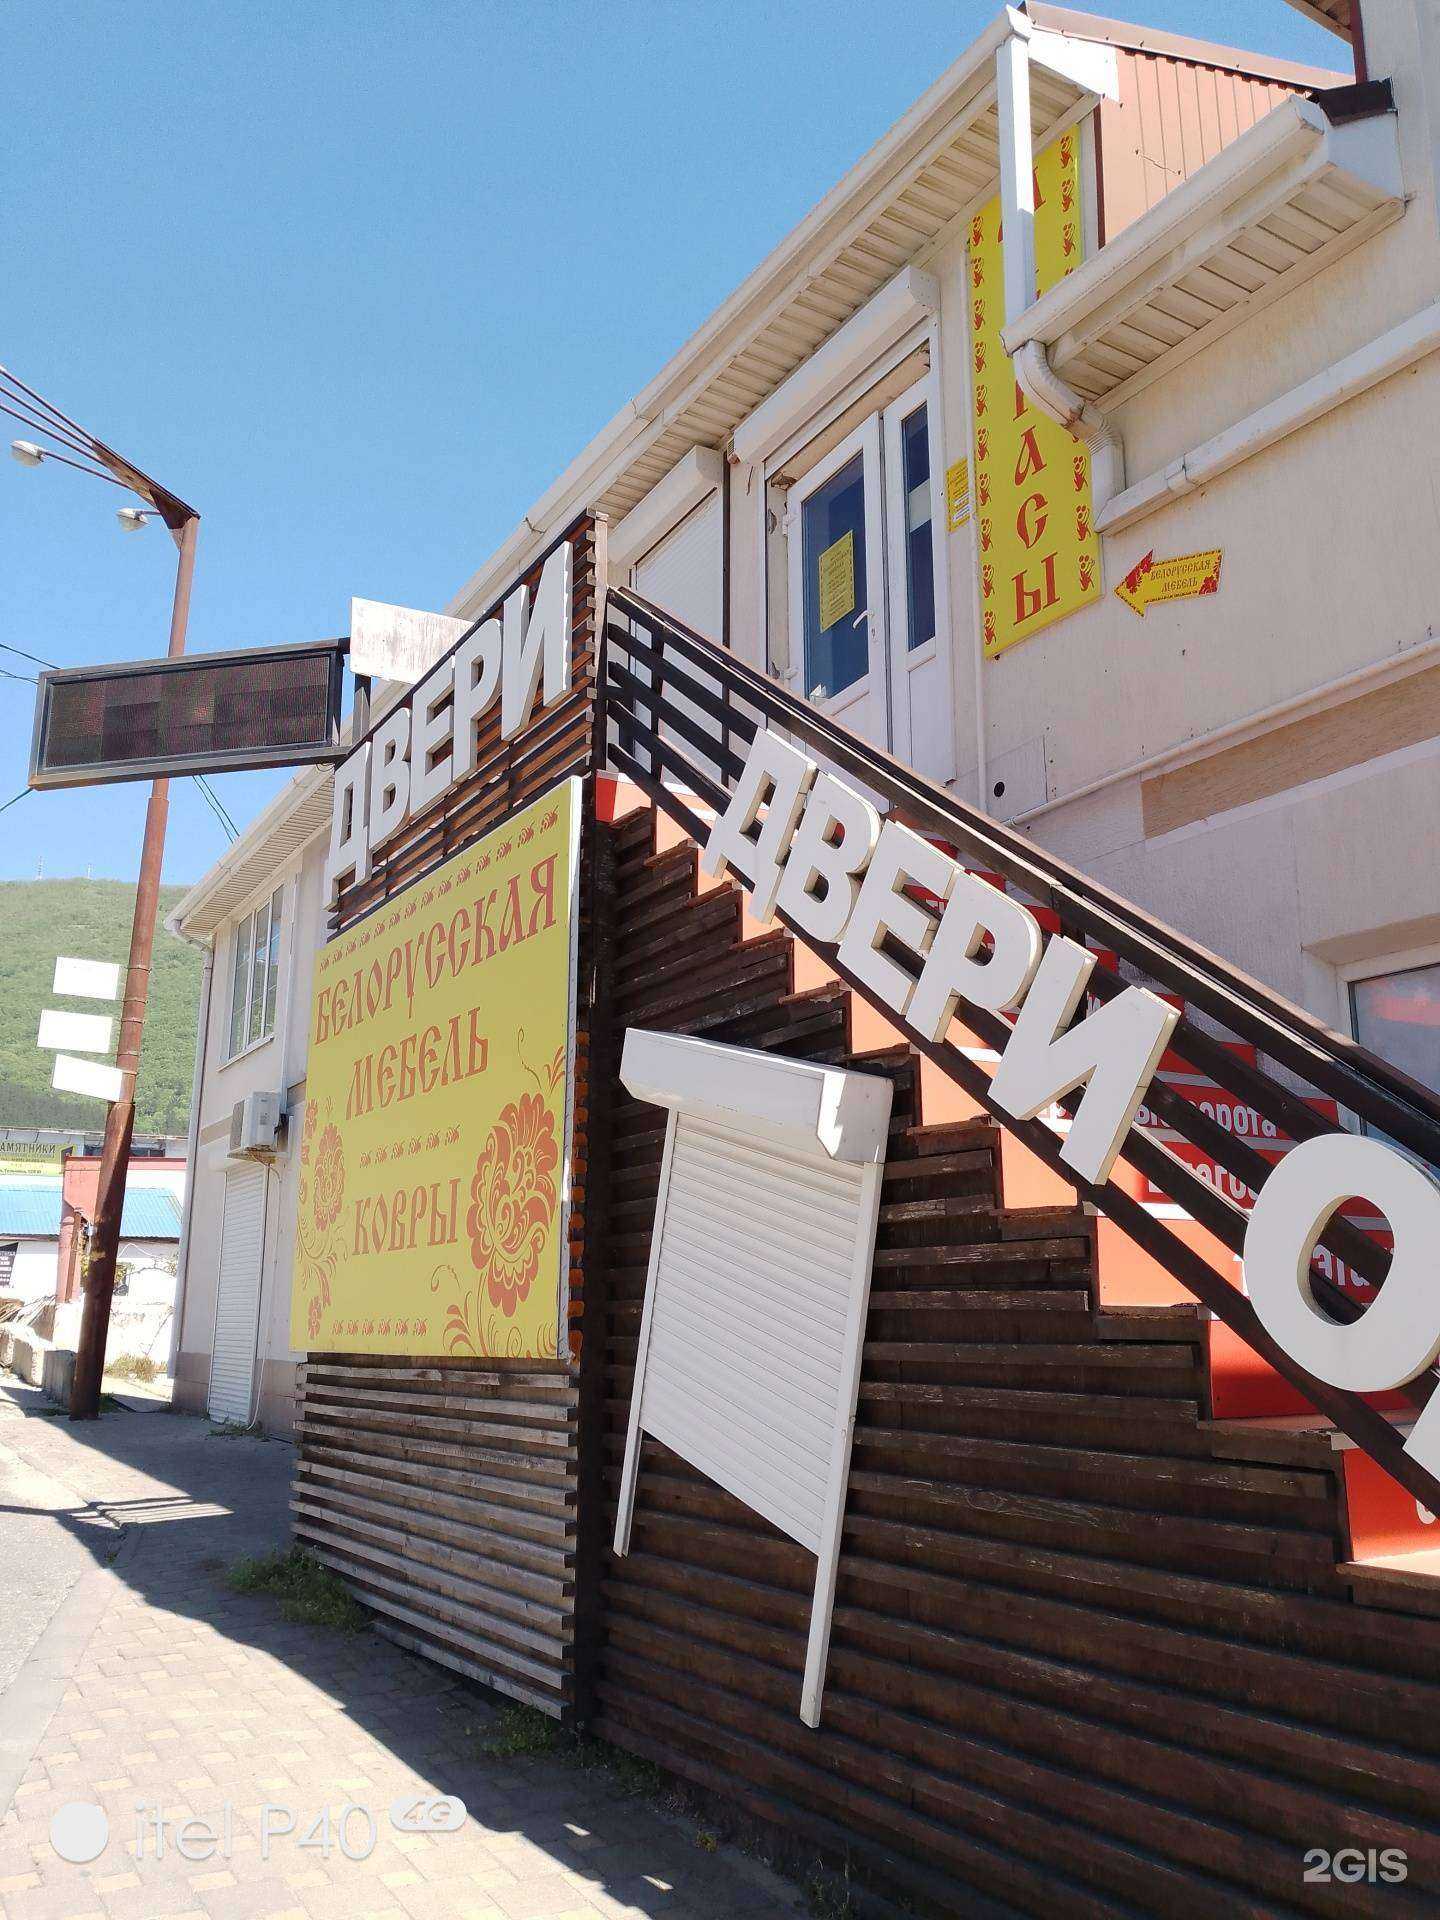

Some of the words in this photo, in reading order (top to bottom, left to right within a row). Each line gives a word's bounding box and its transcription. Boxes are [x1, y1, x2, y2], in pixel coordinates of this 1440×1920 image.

[323, 540, 574, 912] ДВЕРИ
[315, 852, 560, 1046] БЕЛОРУССКАЯ
[345, 1005, 489, 1121] МЕБЕЛЬ
[703, 726, 1181, 1186] ДВЕРИ
[1244, 1133, 1440, 1485] О
[0, 1142, 56, 1154] АМЯТНИКИ
[352, 1177, 462, 1257] КОВРЫ
